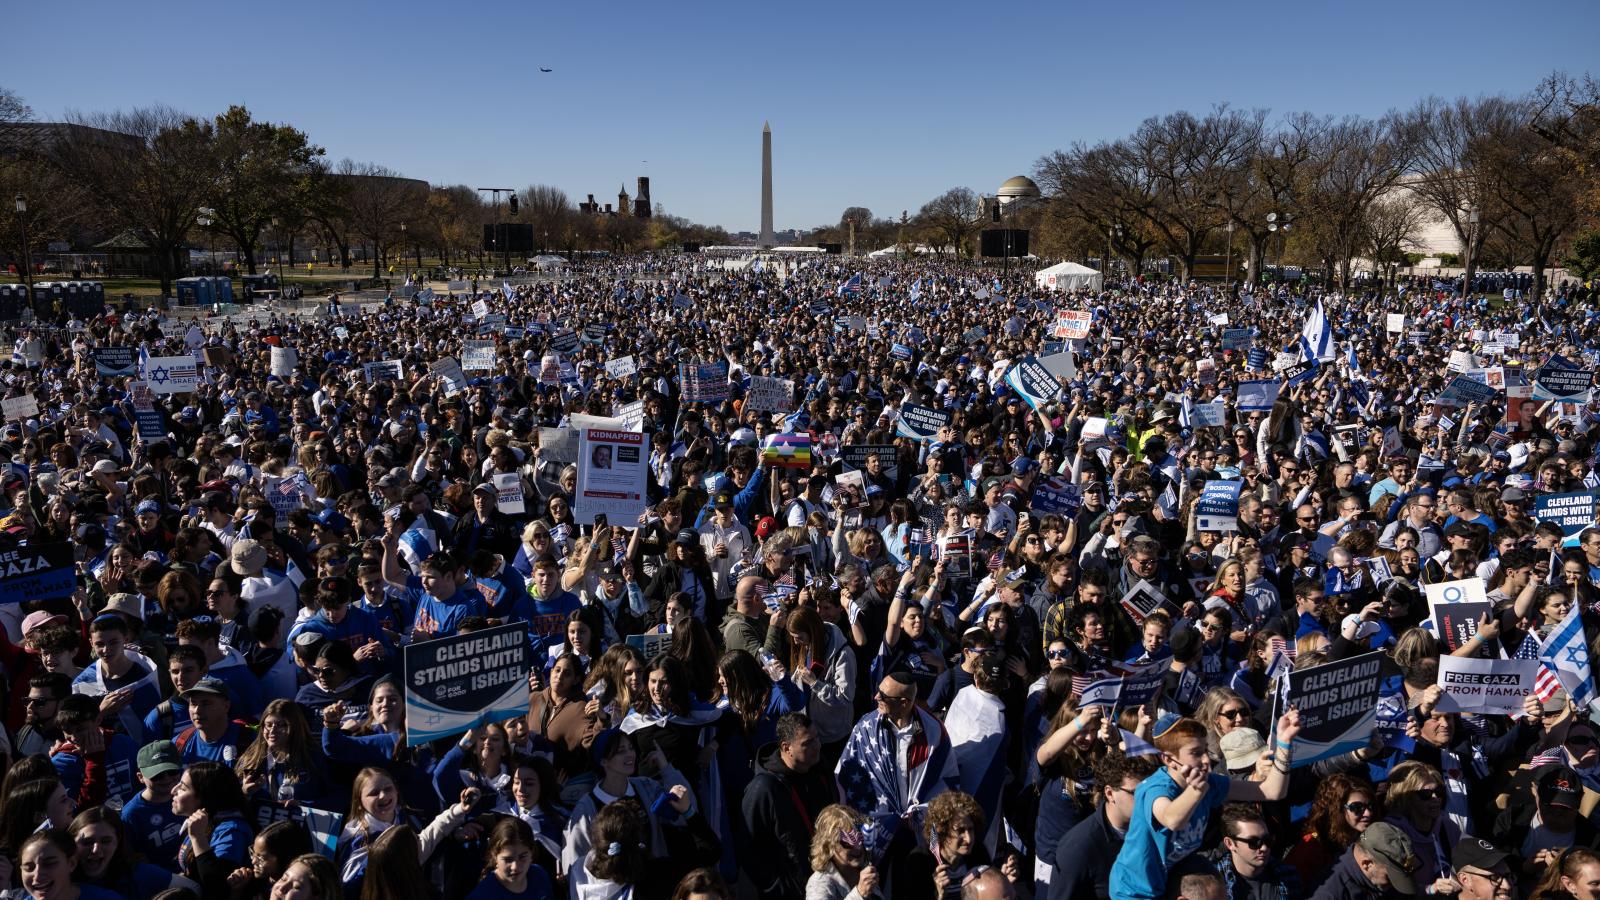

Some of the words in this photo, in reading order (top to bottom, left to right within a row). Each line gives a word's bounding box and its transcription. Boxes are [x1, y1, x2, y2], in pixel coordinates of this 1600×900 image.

[1060, 312, 1078, 320] PROUD
[1021, 362, 1042, 382] STANDS
[1039, 380, 1054, 395] WITH
[1031, 363, 1059, 391] CLEVELAND
[1288, 367, 1307, 378] GAZA
[1031, 382, 1049, 400] ISRAEL
[904, 412, 928, 423] STANDS
[928, 418, 945, 426] WITH
[912, 407, 947, 420] CLEVELAND
[922, 423, 940, 432] ISRA
[590, 431, 640, 440] KIDNAPPED
[1036, 489, 1047, 497] DC
[1547, 496, 1592, 507] CLEVELAND
[1538, 507, 1569, 518] STANDS
[1569, 506, 1592, 515] WITH
[1563, 516, 1591, 525] ISRAEL
[4, 578, 40, 592] FROM
[24, 580, 72, 598] HAMAS
[1465, 618, 1475, 635] and
[1457, 623, 1467, 645] otect
[436, 630, 524, 662] CLEVELAND
[414, 657, 481, 686] STANDS
[482, 647, 523, 670] WITH
[471, 665, 524, 690] ISRAEL
[1302, 660, 1380, 692] CLEVELAND
[1446, 672, 1479, 683] FREE
[1482, 674, 1518, 684] GAZA
[1126, 679, 1162, 690] ISRAEL
[447, 689, 466, 698] GOOD
[1291, 688, 1338, 711] TANDS
[1341, 677, 1377, 700] WITH
[1446, 686, 1480, 695] FROM
[1485, 688, 1529, 697] HAMAS
[1328, 696, 1373, 721] ISRAEL
[1374, 720, 1406, 729] SRAE
